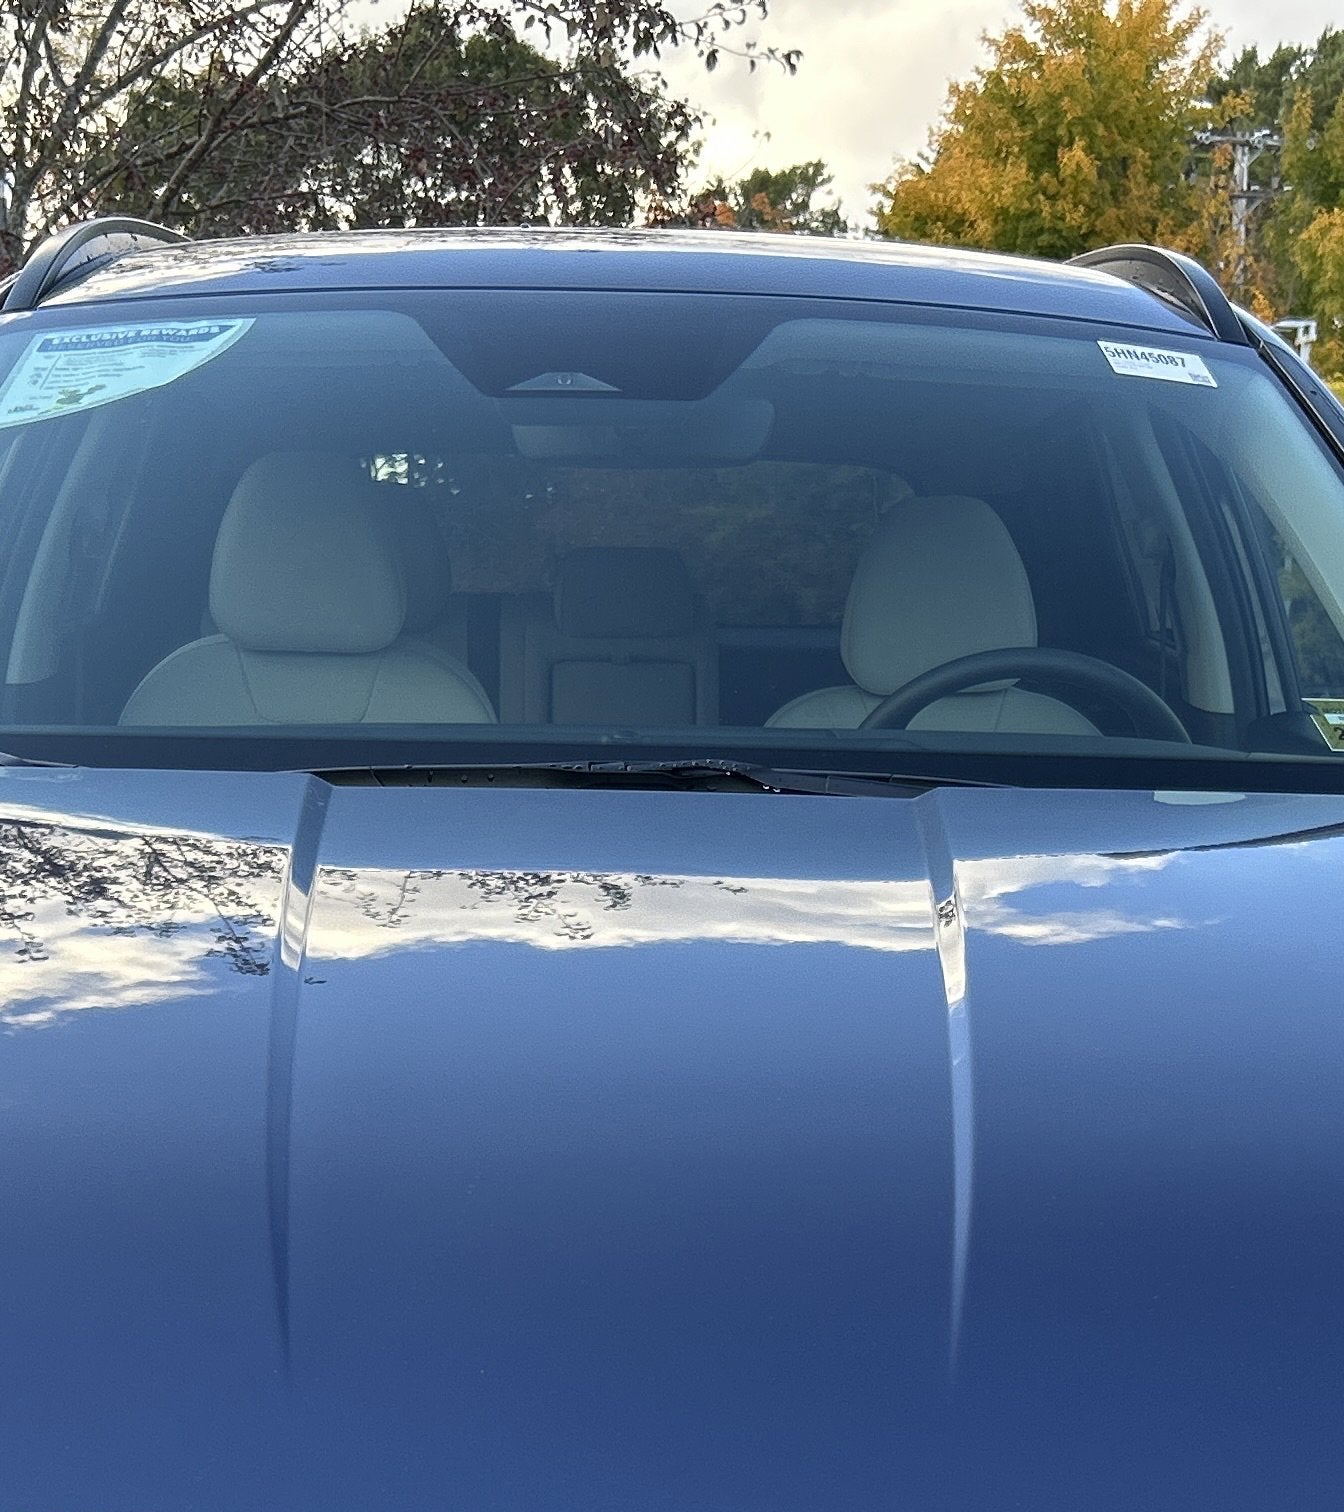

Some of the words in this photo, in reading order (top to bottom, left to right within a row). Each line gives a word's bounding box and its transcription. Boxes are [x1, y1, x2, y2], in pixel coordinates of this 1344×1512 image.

[52, 329, 136, 345] EXCLUSIVE
[140, 325, 221, 338] REWARDS
[1103, 346, 1186, 368] 5HN45087
